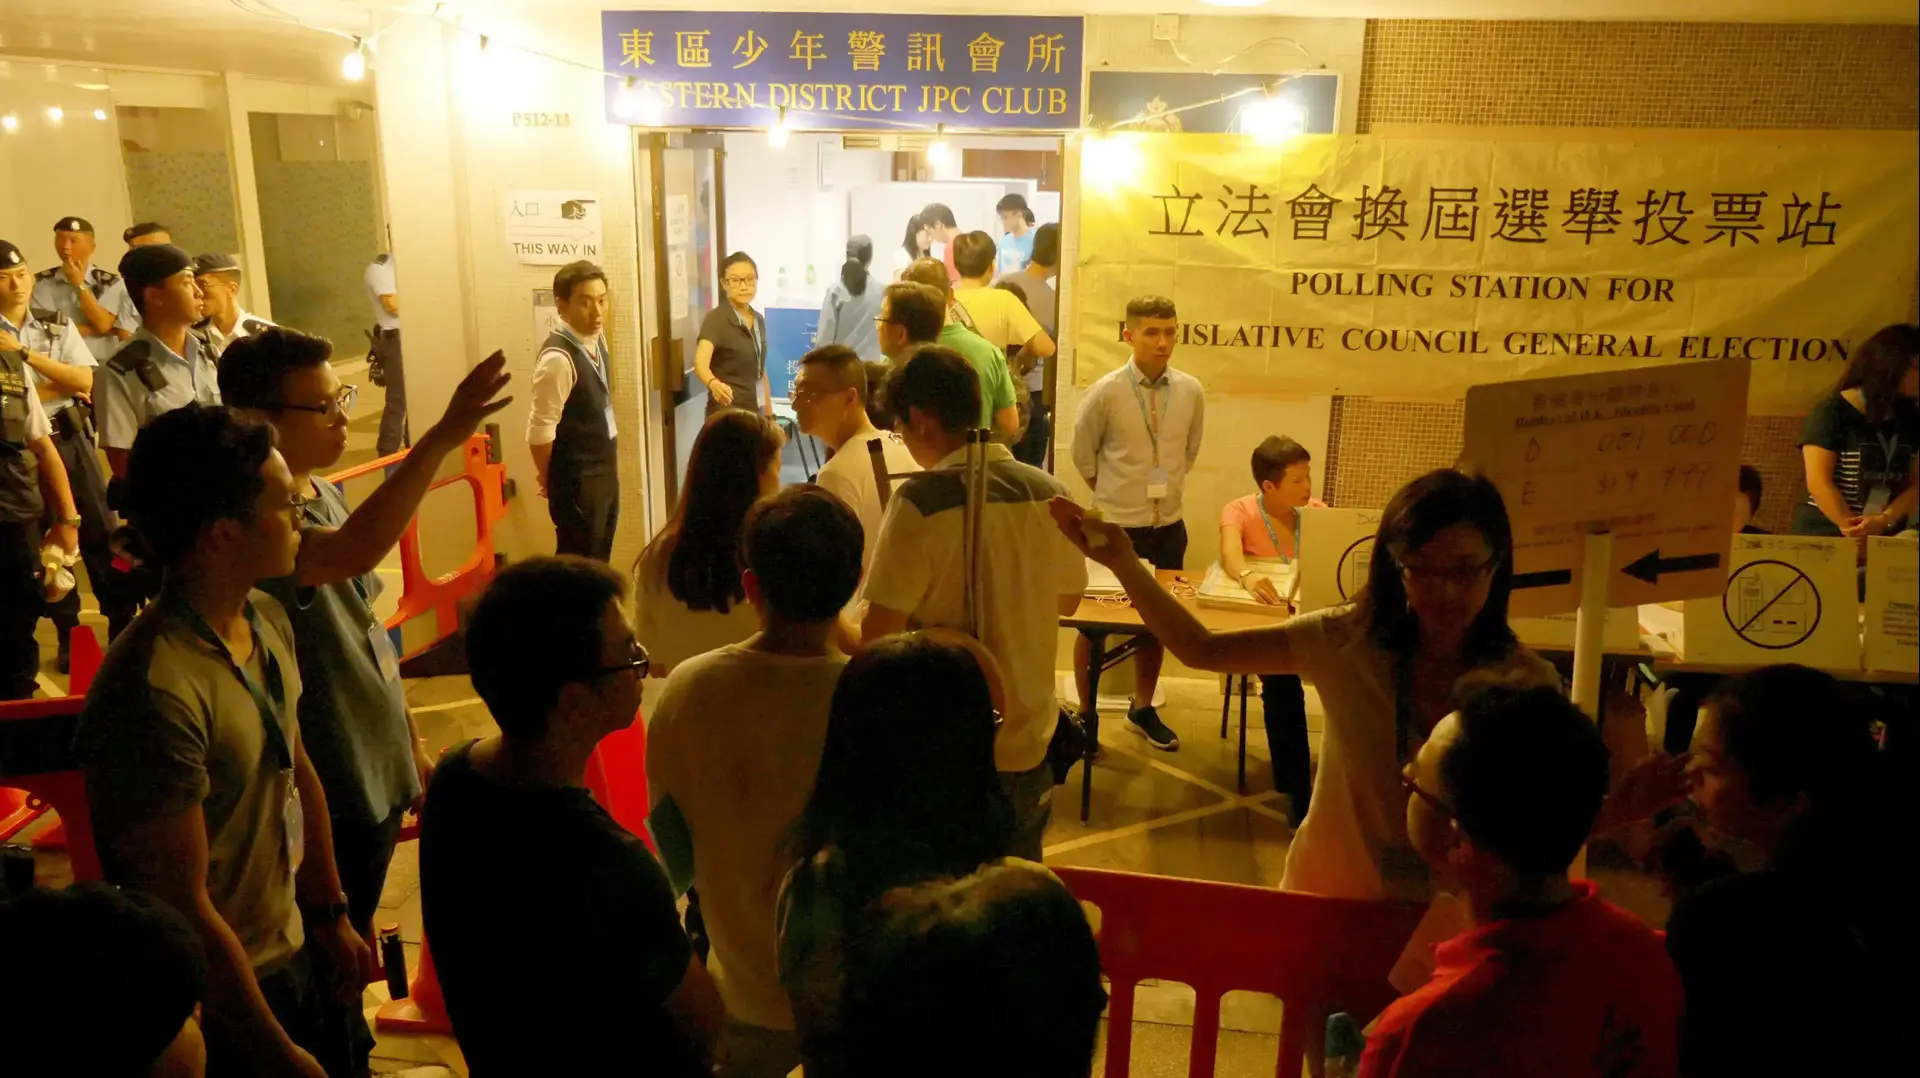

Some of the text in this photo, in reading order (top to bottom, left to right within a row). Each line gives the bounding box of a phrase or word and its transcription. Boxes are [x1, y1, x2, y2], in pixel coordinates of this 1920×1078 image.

[618, 28, 1066, 75] 東區少年警訊會所
[617, 80, 1067, 115] STERN DISTRICT JPC CLUB
[509, 200, 539, 218] 入口
[1148, 183, 1842, 247] 立法會換屆選舉投票站
[513, 243, 597, 256] THIS WAY IN
[1291, 272, 1675, 303] POLLING STATION FOR
[1341, 326, 1488, 354] COUNCIL
[1503, 331, 1663, 359] GENERAL
[1678, 335, 1851, 362] ELECTION
